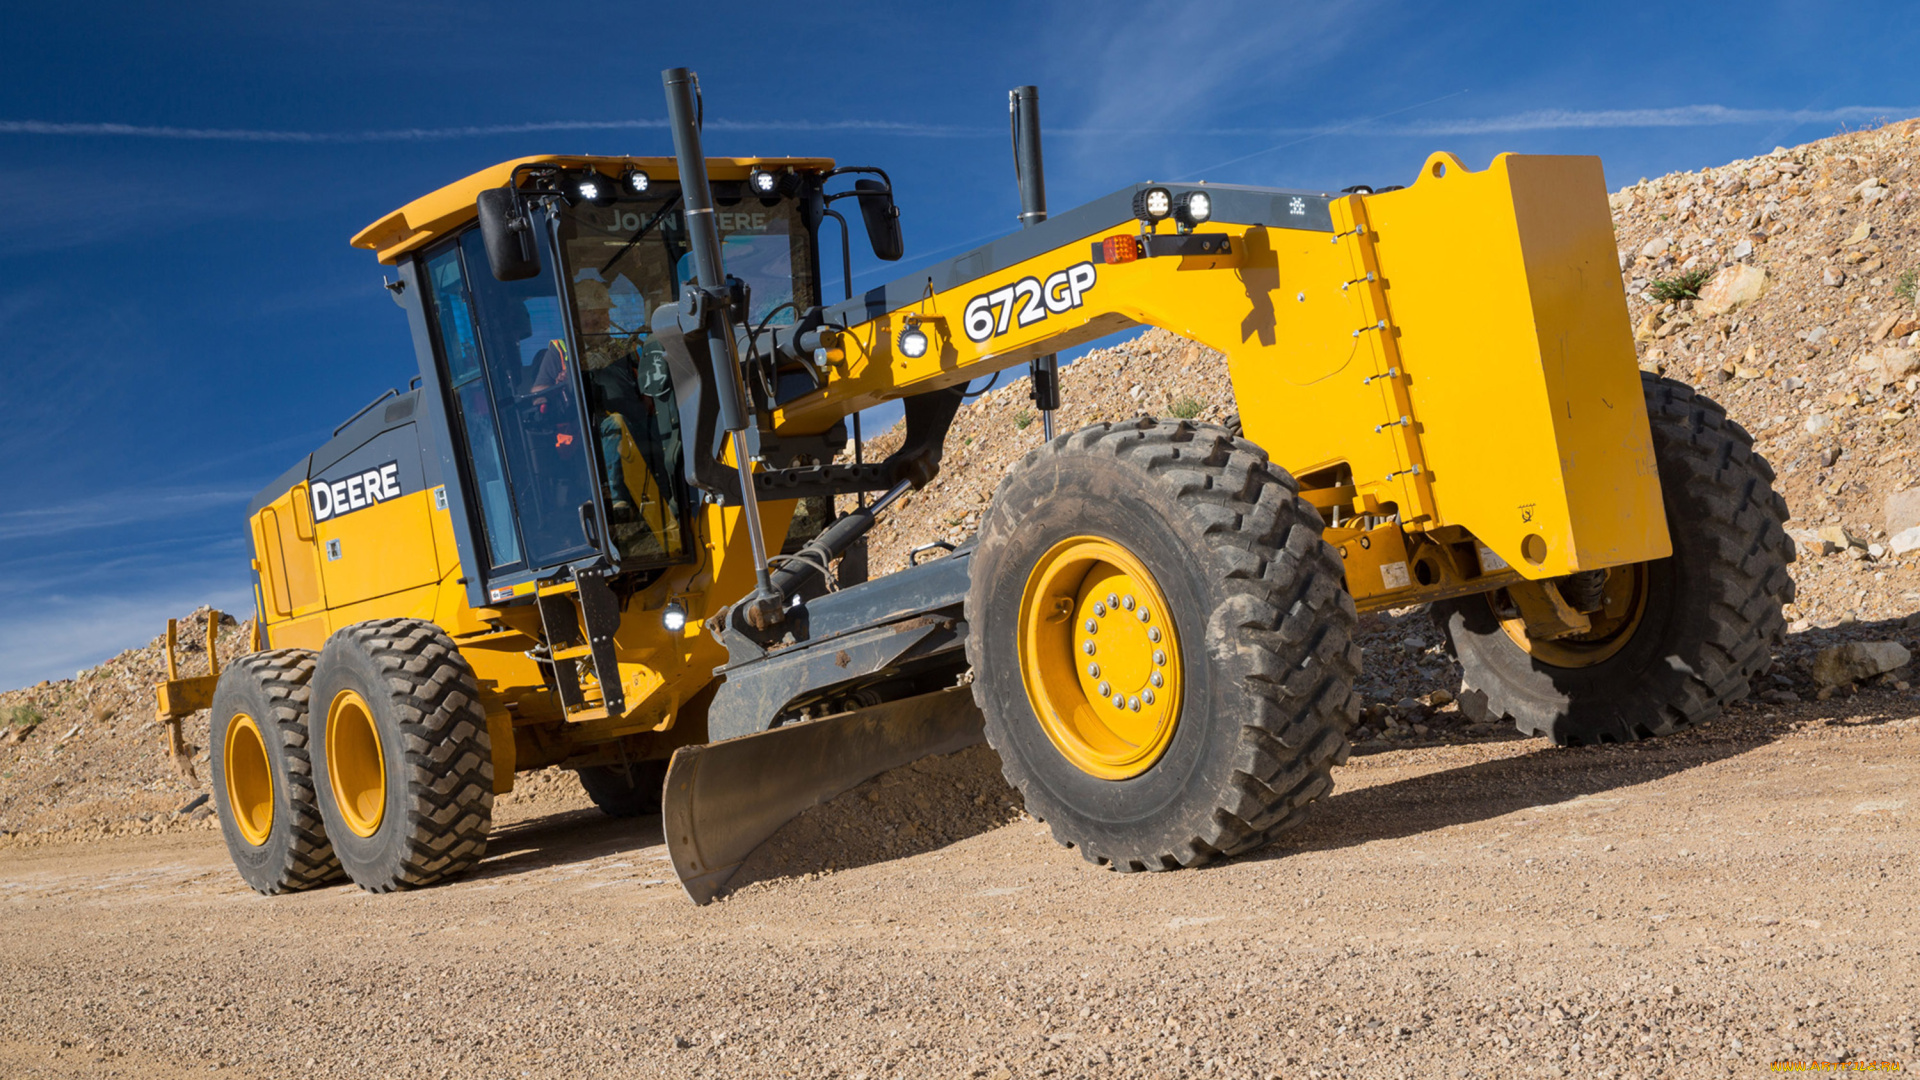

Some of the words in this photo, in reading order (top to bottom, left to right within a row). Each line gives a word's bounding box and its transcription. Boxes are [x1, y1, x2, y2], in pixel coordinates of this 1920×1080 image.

[686, 212, 767, 231] EERE
[964, 262, 1096, 341] 672GP
[311, 462, 400, 521] DEERE
